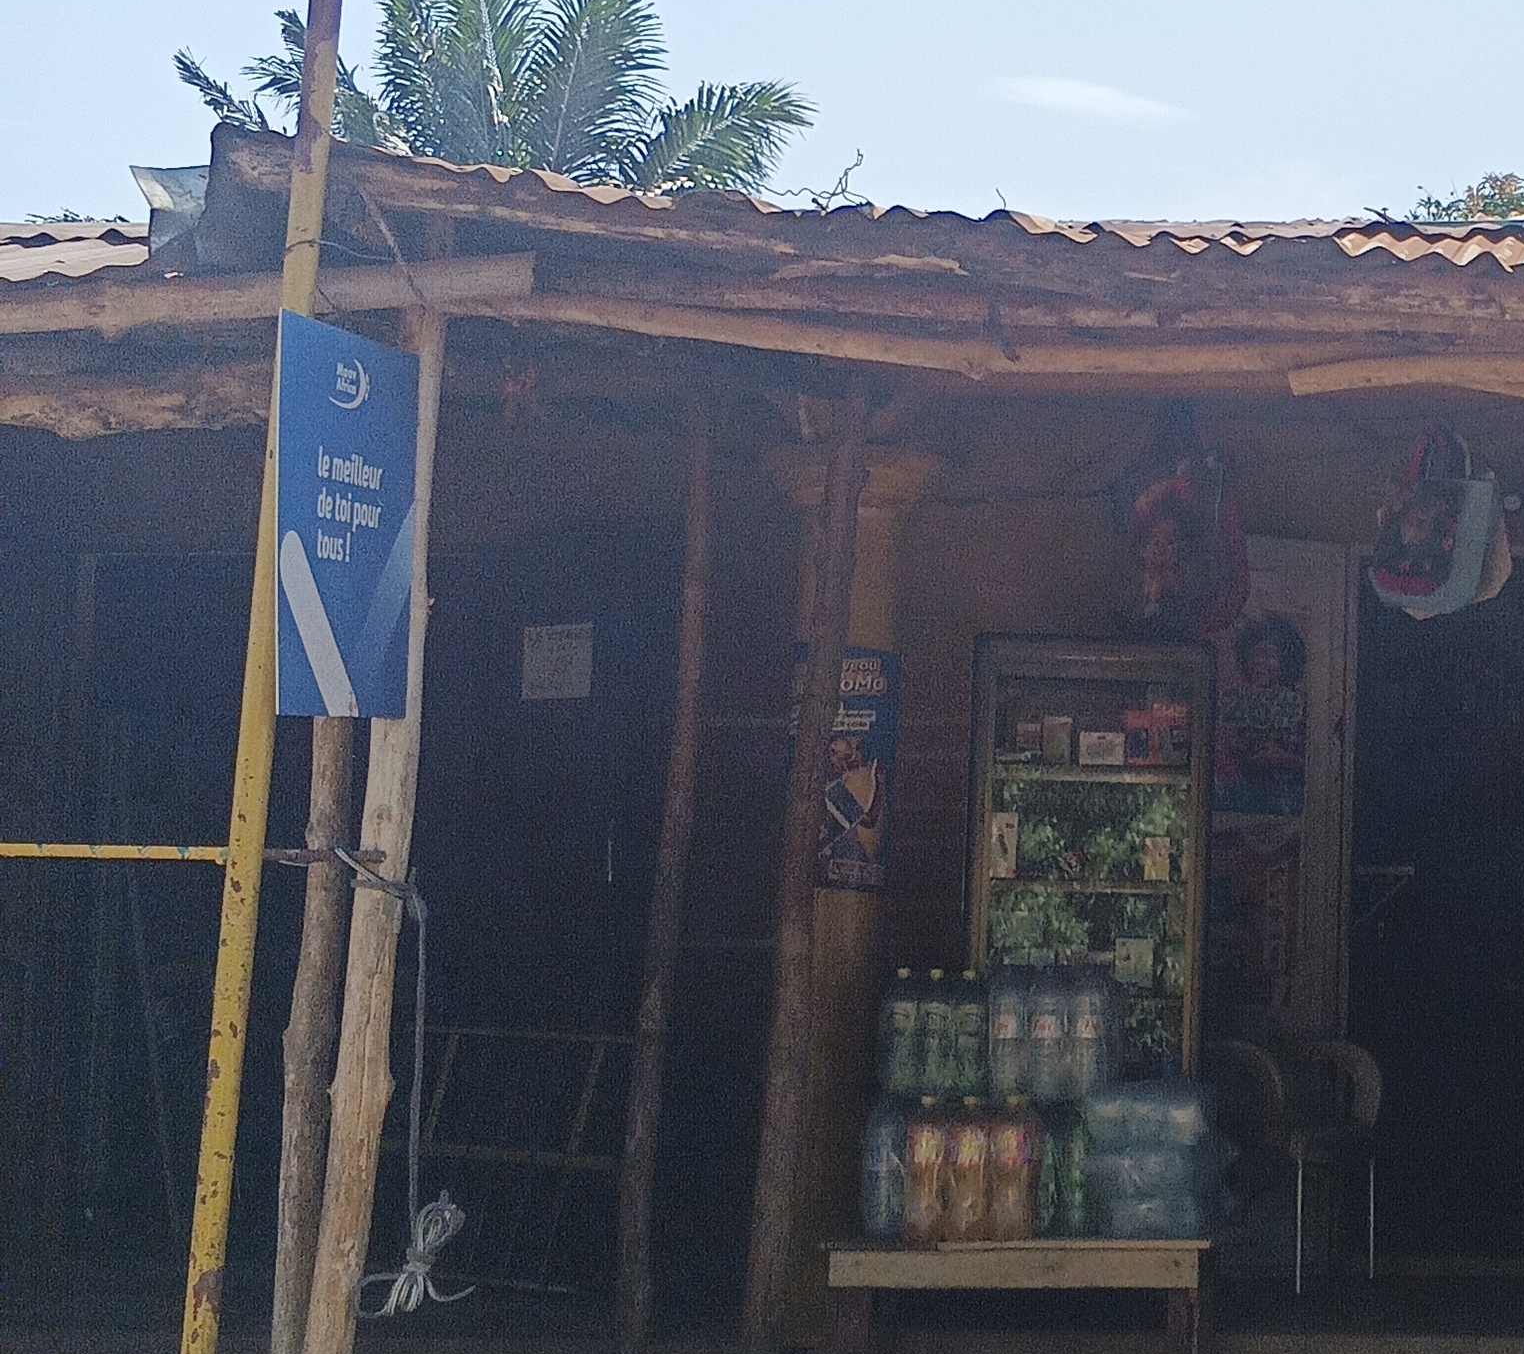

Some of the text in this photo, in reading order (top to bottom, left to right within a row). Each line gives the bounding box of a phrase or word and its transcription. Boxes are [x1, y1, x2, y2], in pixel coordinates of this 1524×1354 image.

[318, 446, 382, 490] le meilleur
[317, 487, 382, 532] de toi pour
